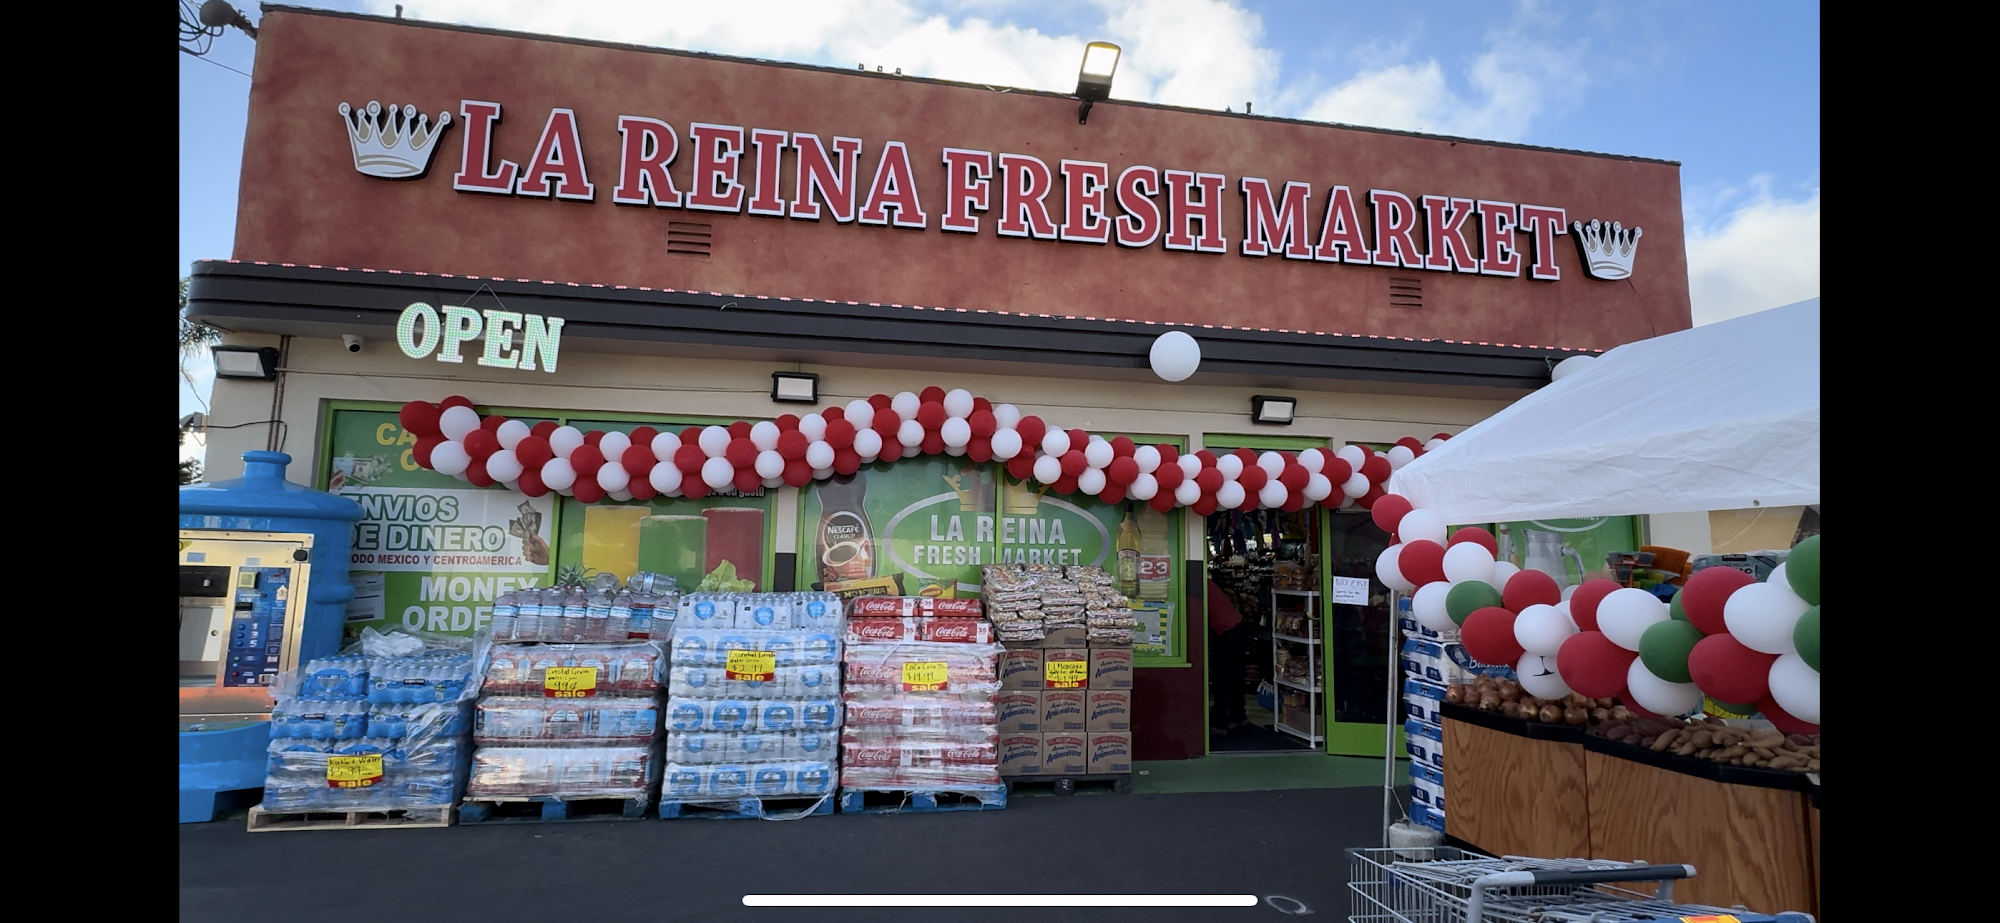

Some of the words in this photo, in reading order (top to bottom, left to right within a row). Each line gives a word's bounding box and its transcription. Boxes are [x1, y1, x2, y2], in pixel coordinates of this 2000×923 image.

[453, 99, 595, 201] LA
[612, 114, 926, 228] REINA
[941, 147, 1227, 254] FRESH
[1240, 176, 1567, 281] MARKET
[396, 301, 565, 373] OPEN
[386, 523, 506, 552] DINERO
[931, 514, 964, 542] LA
[976, 515, 1066, 545] REINA
[351, 553, 375, 564] ODO
[377, 554, 420, 566] MEXICO
[424, 555, 432, 566] Y
[433, 555, 523, 567] CENTROAMERICA
[913, 545, 981, 566] FRESH
[990, 547, 1082, 566] MARKET
[420, 576, 539, 602] MONEY
[402, 605, 493, 632] ORDE
[250, 640, 258, 648] 5
[734, 673, 765, 681] sale
[1054, 680, 1079, 688] sale
[554, 689, 586, 698] sale
[911, 683, 940, 691] sale
[337, 778, 373, 788] sale
